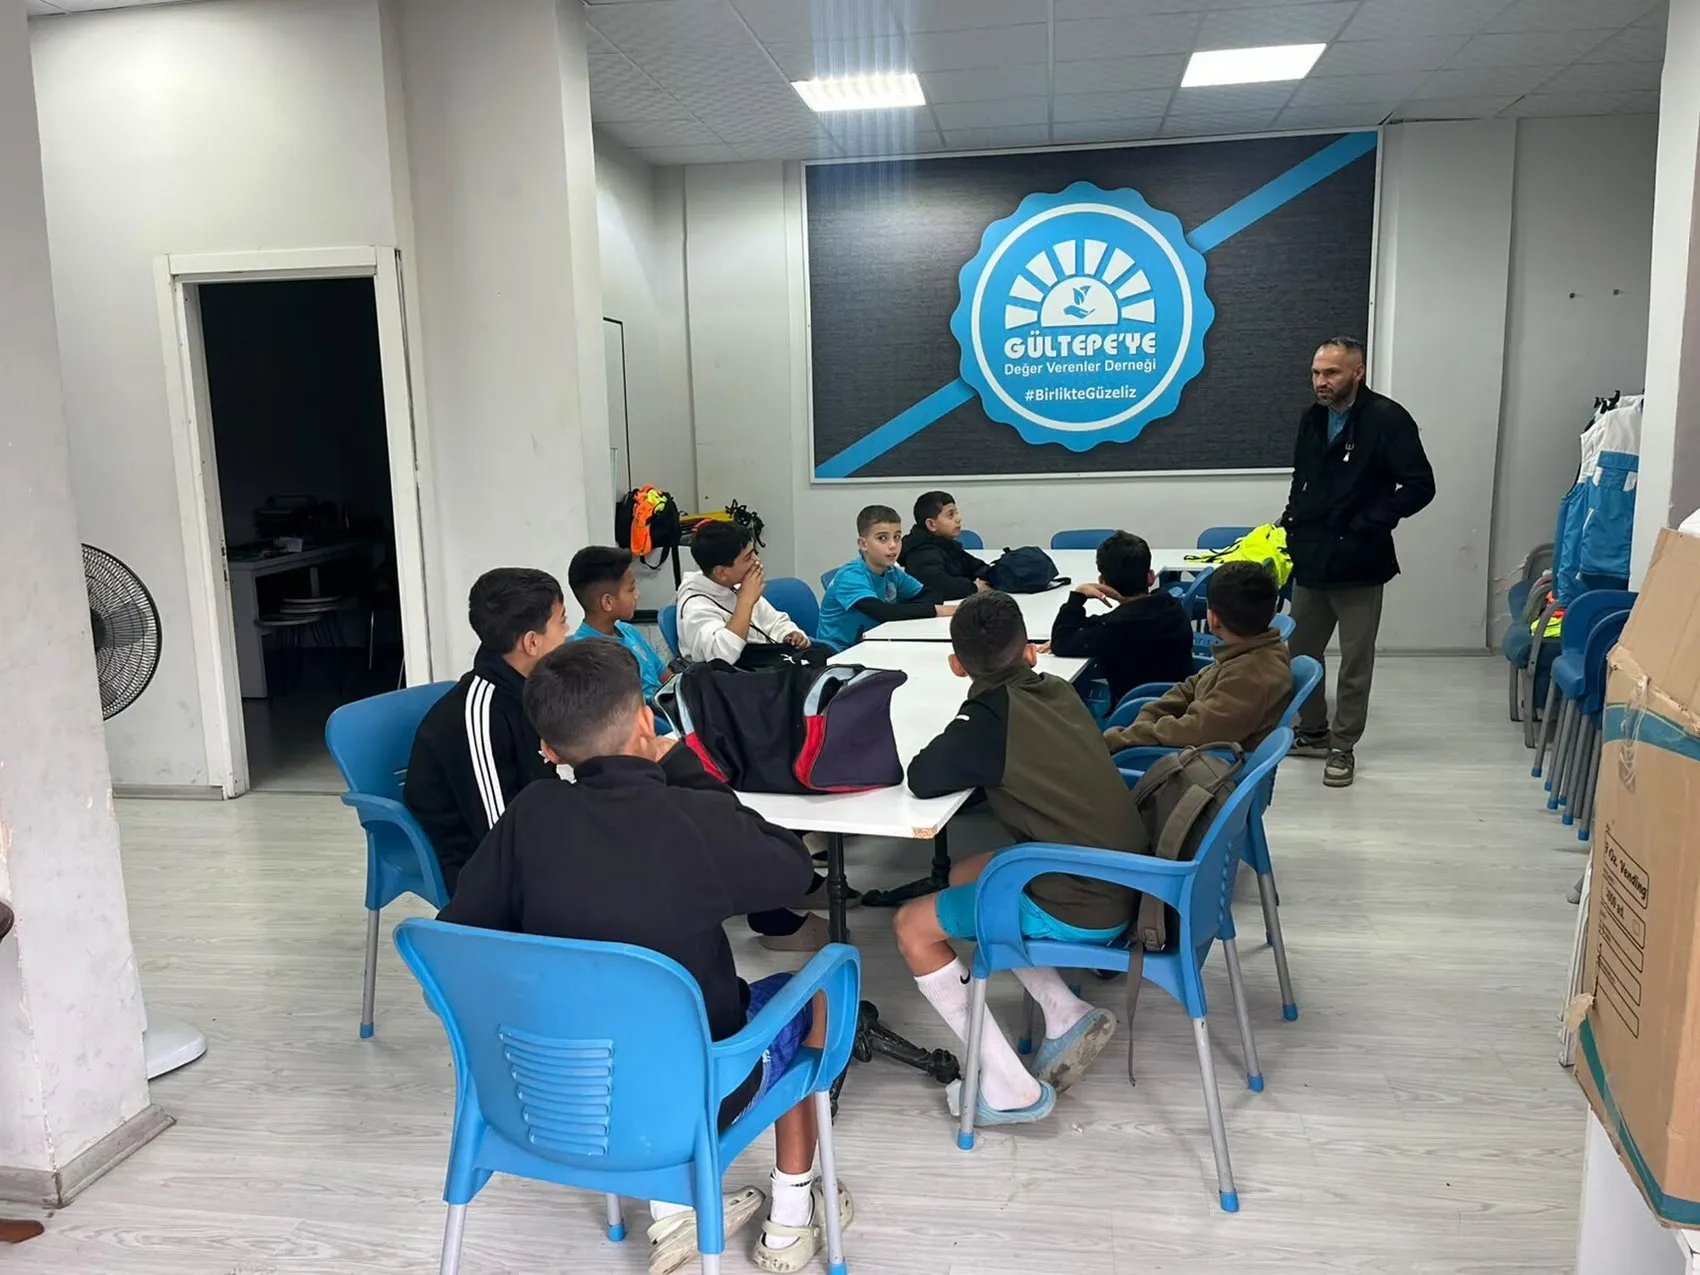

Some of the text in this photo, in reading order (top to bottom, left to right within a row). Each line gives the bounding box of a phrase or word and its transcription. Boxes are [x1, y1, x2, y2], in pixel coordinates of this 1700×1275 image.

[1004, 330, 1156, 359] GÜLTEPE'YE
[1004, 358, 1156, 377] Değer Verenler Derneği
[1024, 385, 1137, 402] #BirlikteGüzeliz
[1620, 859, 1647, 900] Vending
